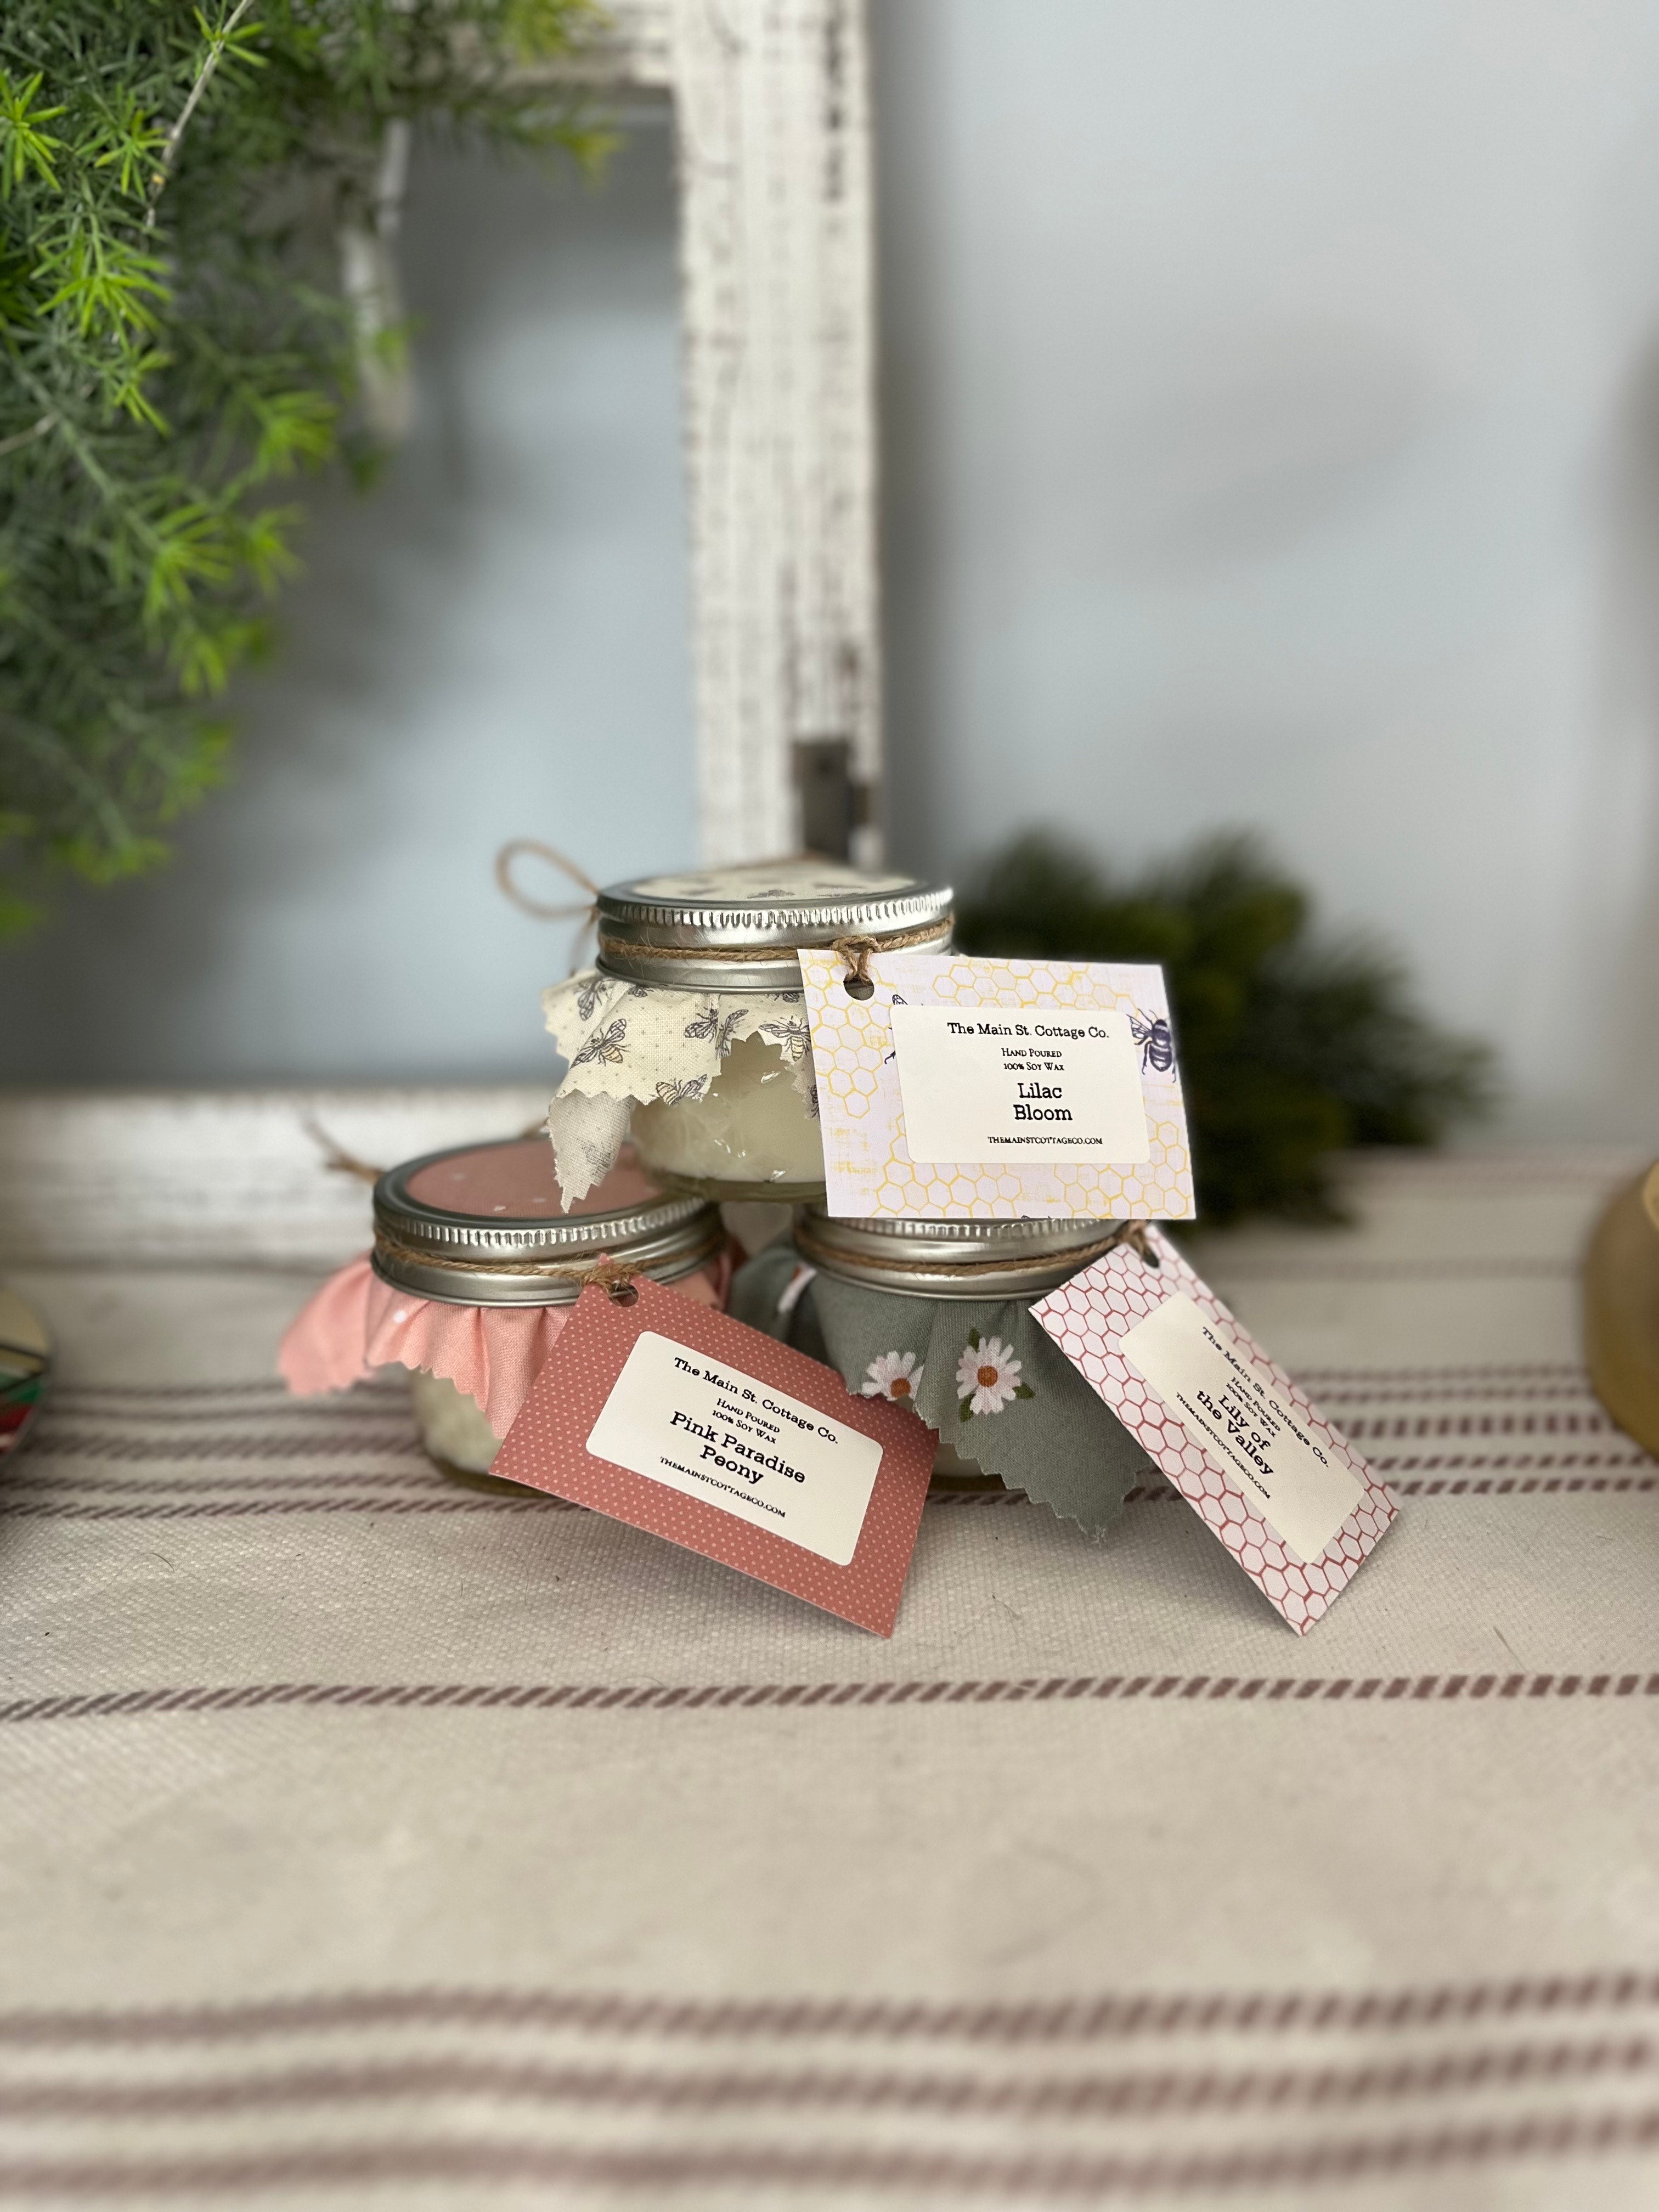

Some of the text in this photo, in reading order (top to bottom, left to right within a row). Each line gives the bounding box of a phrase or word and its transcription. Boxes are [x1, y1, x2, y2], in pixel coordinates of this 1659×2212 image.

[947, 1023, 1109, 1040] The Main St. Cottage Co.
[1017, 1082, 1063, 1099] Lilac
[1013, 1104, 1073, 1121] Bloom
[674, 1357, 838, 1444] The Main St. Cottage Co.
[1203, 1327, 1329, 1468] The Main St. Cottage Co.
[1226, 1383, 1244, 1403] 100%
[712, 1409, 734, 1425] 100%
[1197, 1390, 1274, 1475] the Valley
[1218, 1394, 1271, 1451] Lily of
[669, 1410, 805, 1483] Pink Paradise
[699, 1444, 764, 1485] Peony
